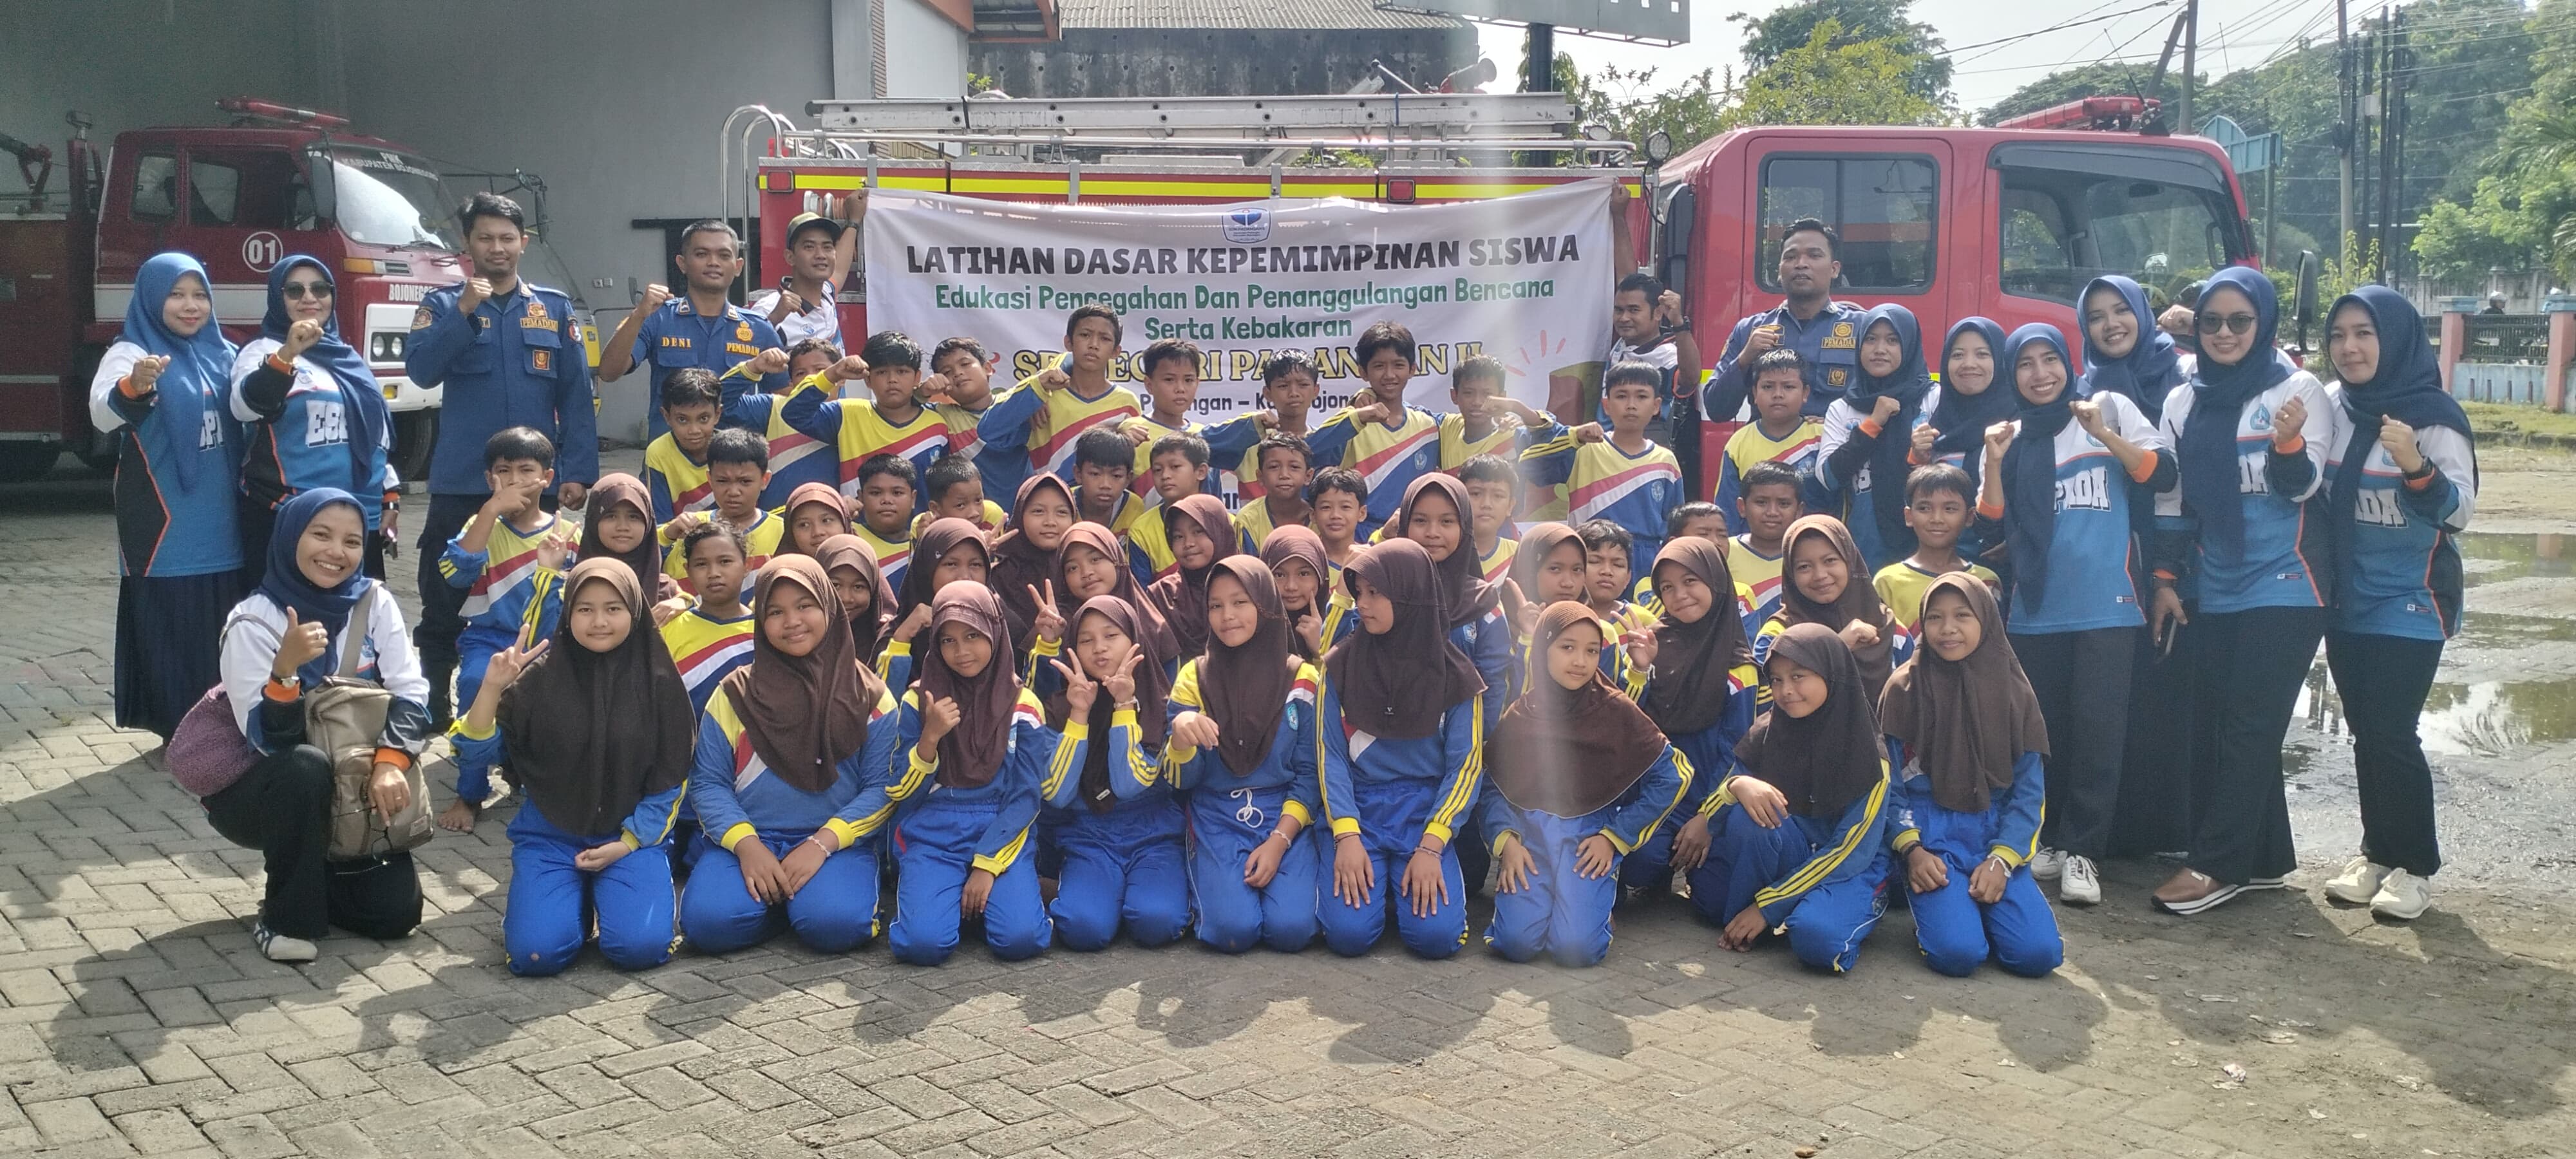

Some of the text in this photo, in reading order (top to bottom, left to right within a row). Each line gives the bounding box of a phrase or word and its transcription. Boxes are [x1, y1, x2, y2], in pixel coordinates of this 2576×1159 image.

[248, 240, 276, 264] 01
[907, 234, 1580, 275] LATIHAN DASAR KEPEMIMPINAN SISWA
[388, 284, 433, 301] BOJONEG
[936, 277, 1555, 316] Edukasi Pencegahan Dan Penanggulangan Bencana
[1144, 314, 1352, 341] Serta Kebakaran
[662, 337, 692, 348] DENI
[726, 343, 760, 356] PEMADAM
